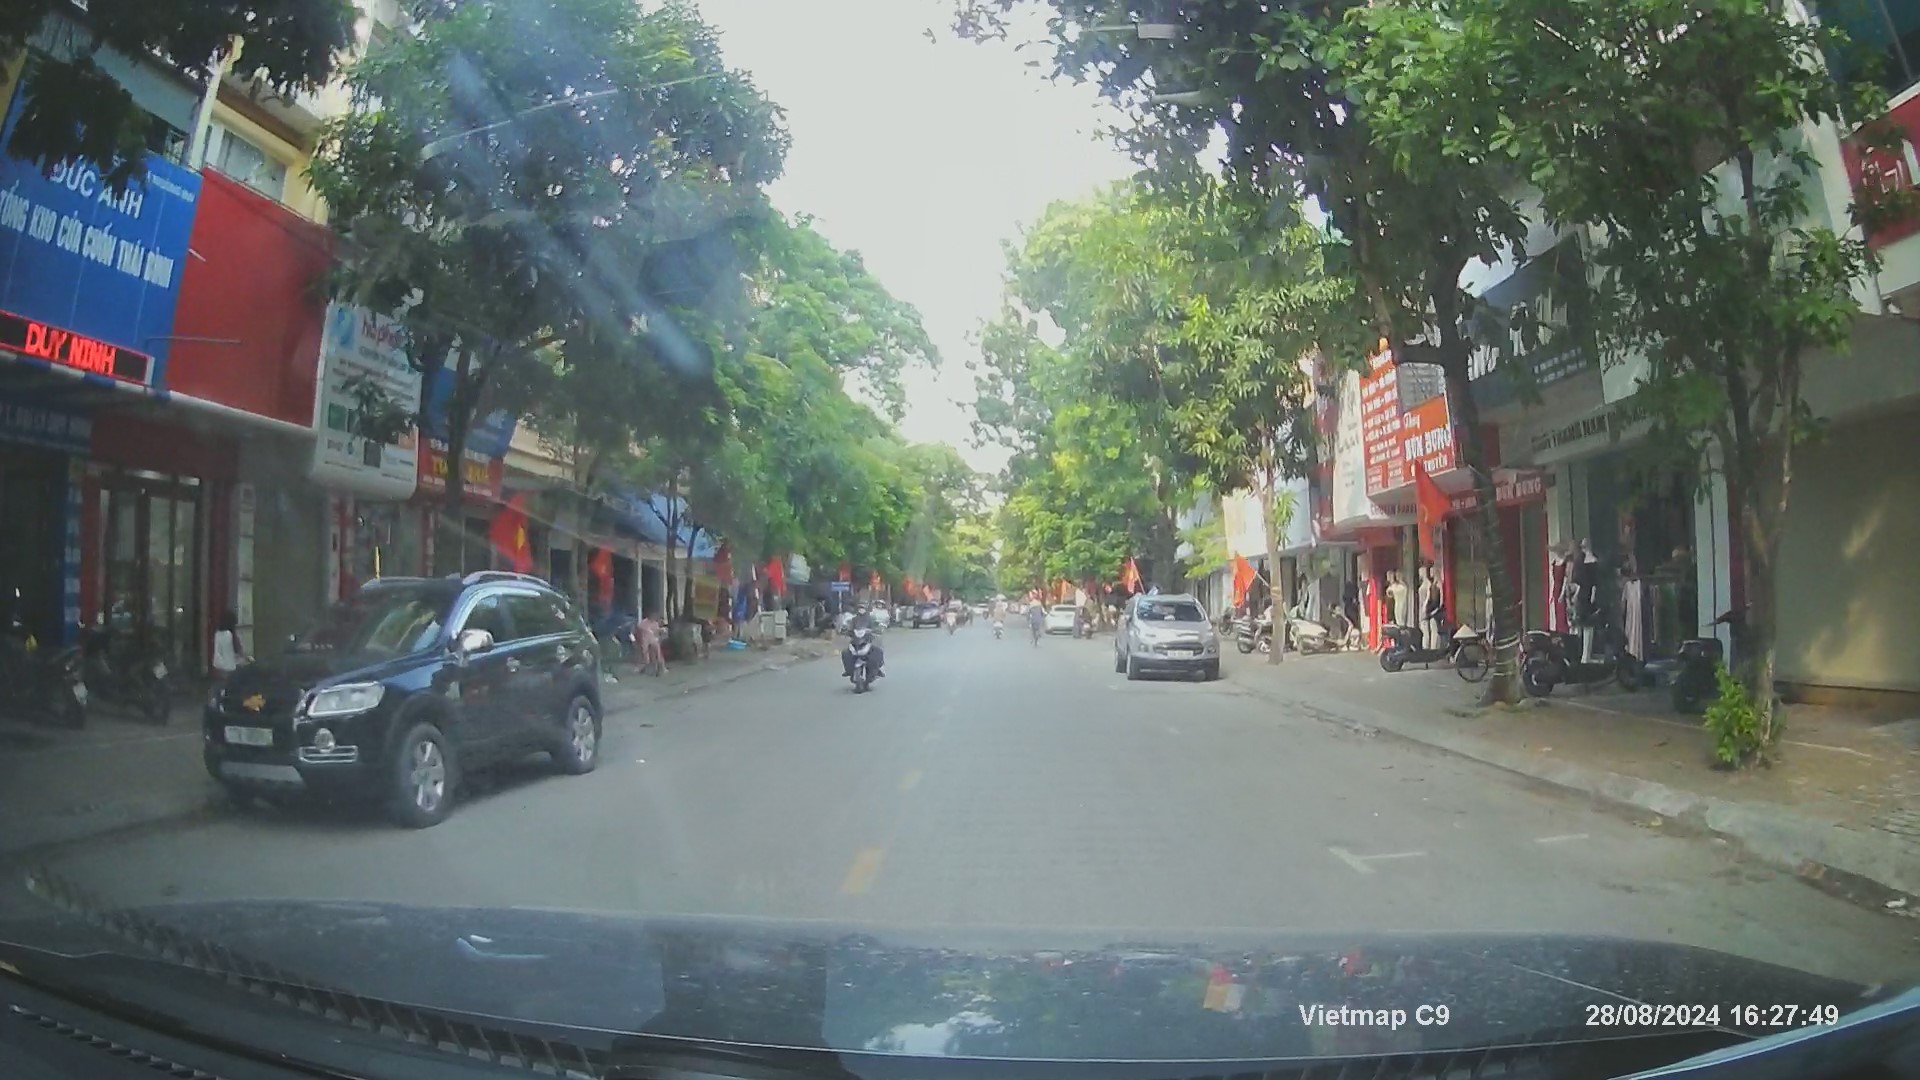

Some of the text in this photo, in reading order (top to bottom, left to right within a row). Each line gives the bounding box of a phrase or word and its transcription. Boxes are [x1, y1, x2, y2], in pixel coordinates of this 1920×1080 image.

[28, 203, 58, 243] KHO
[24, 322, 118, 376] DUY NINH
